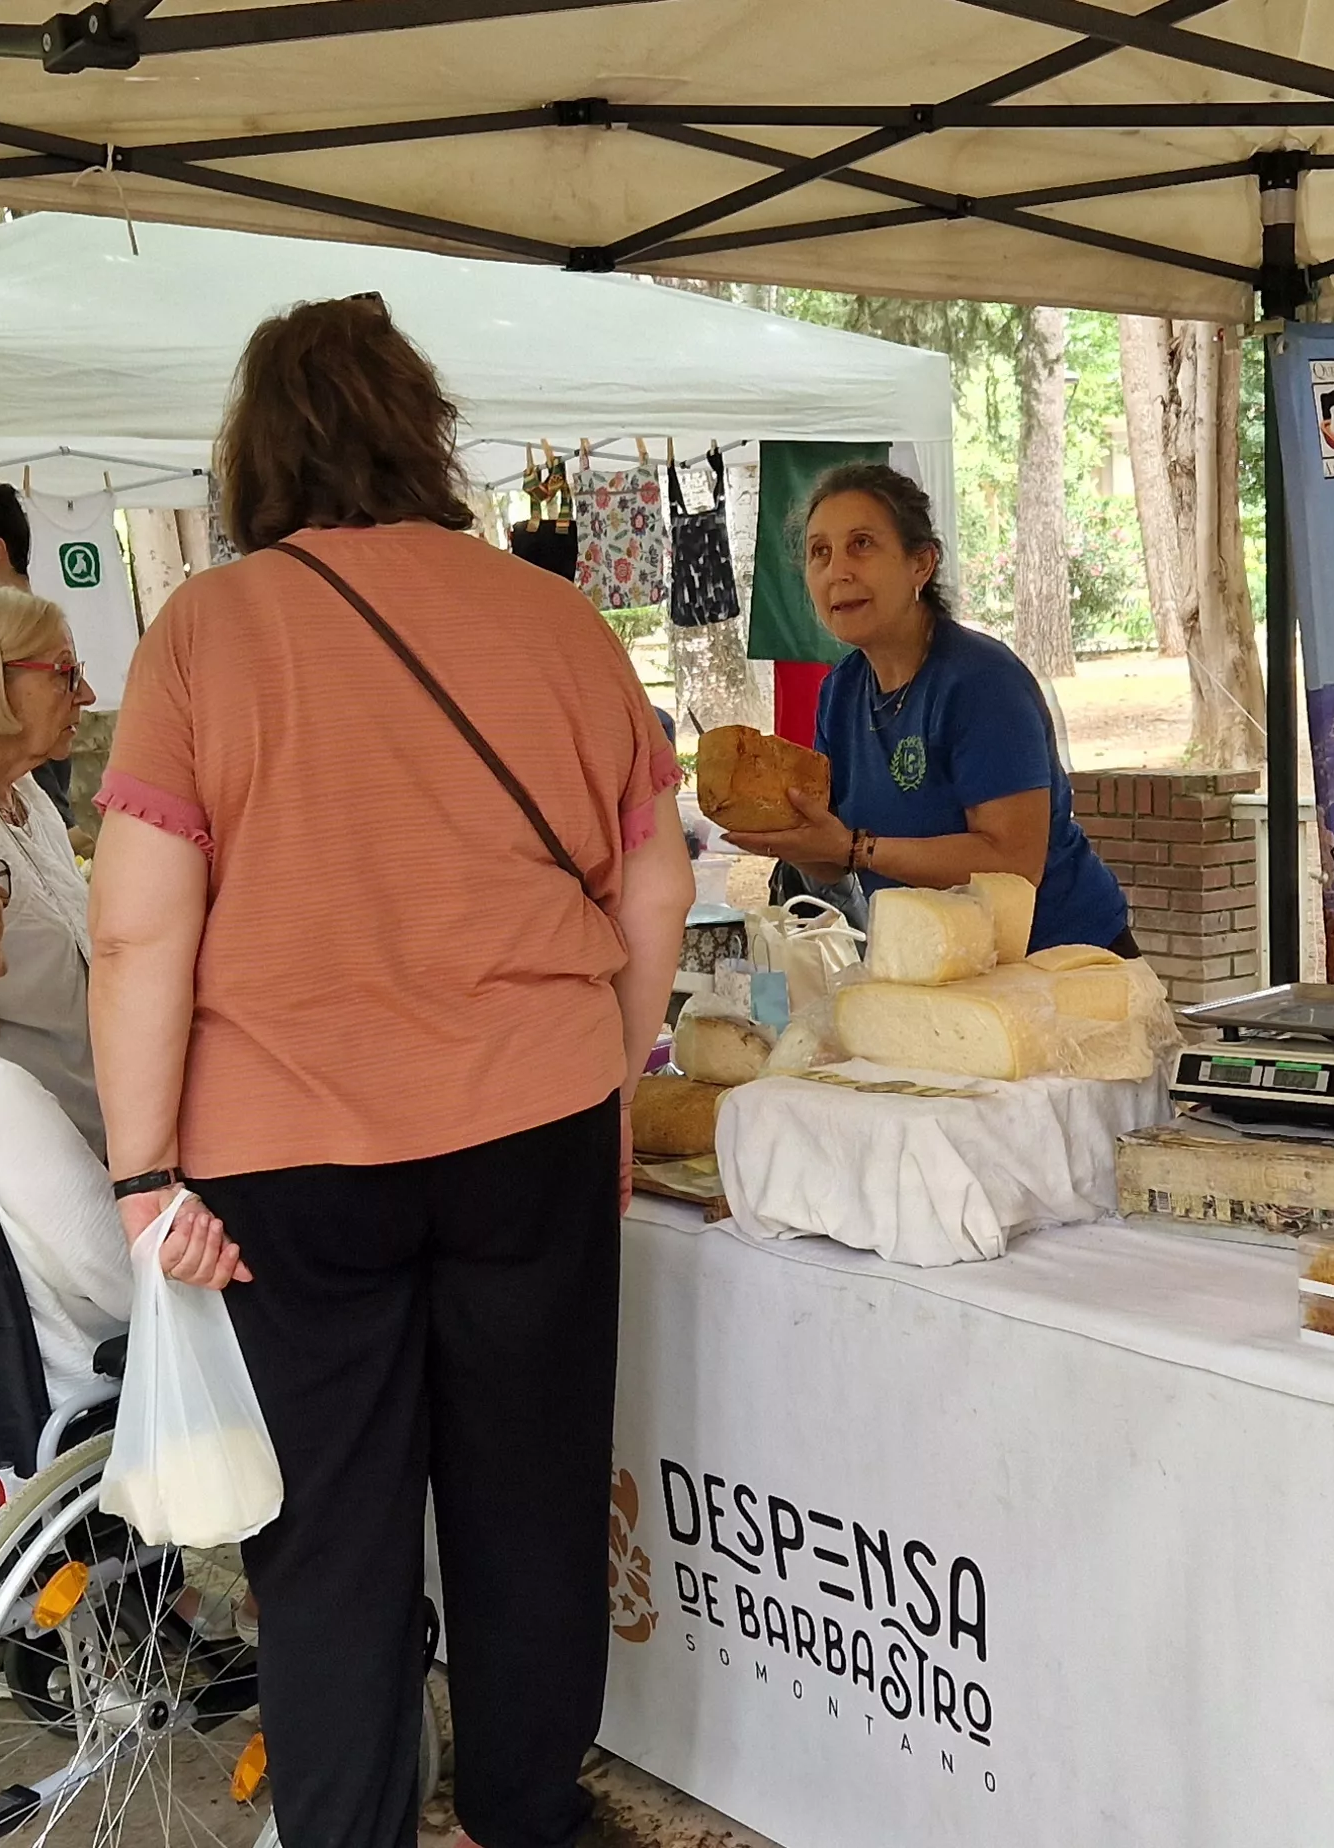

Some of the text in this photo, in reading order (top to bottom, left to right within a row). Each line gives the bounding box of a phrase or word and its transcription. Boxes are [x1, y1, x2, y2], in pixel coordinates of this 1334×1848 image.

[660, 1458, 987, 1662] DESPENSA
[675, 1561, 993, 1746] DE BARBASTRO
[685, 1633, 997, 1793] SOMONTANO
